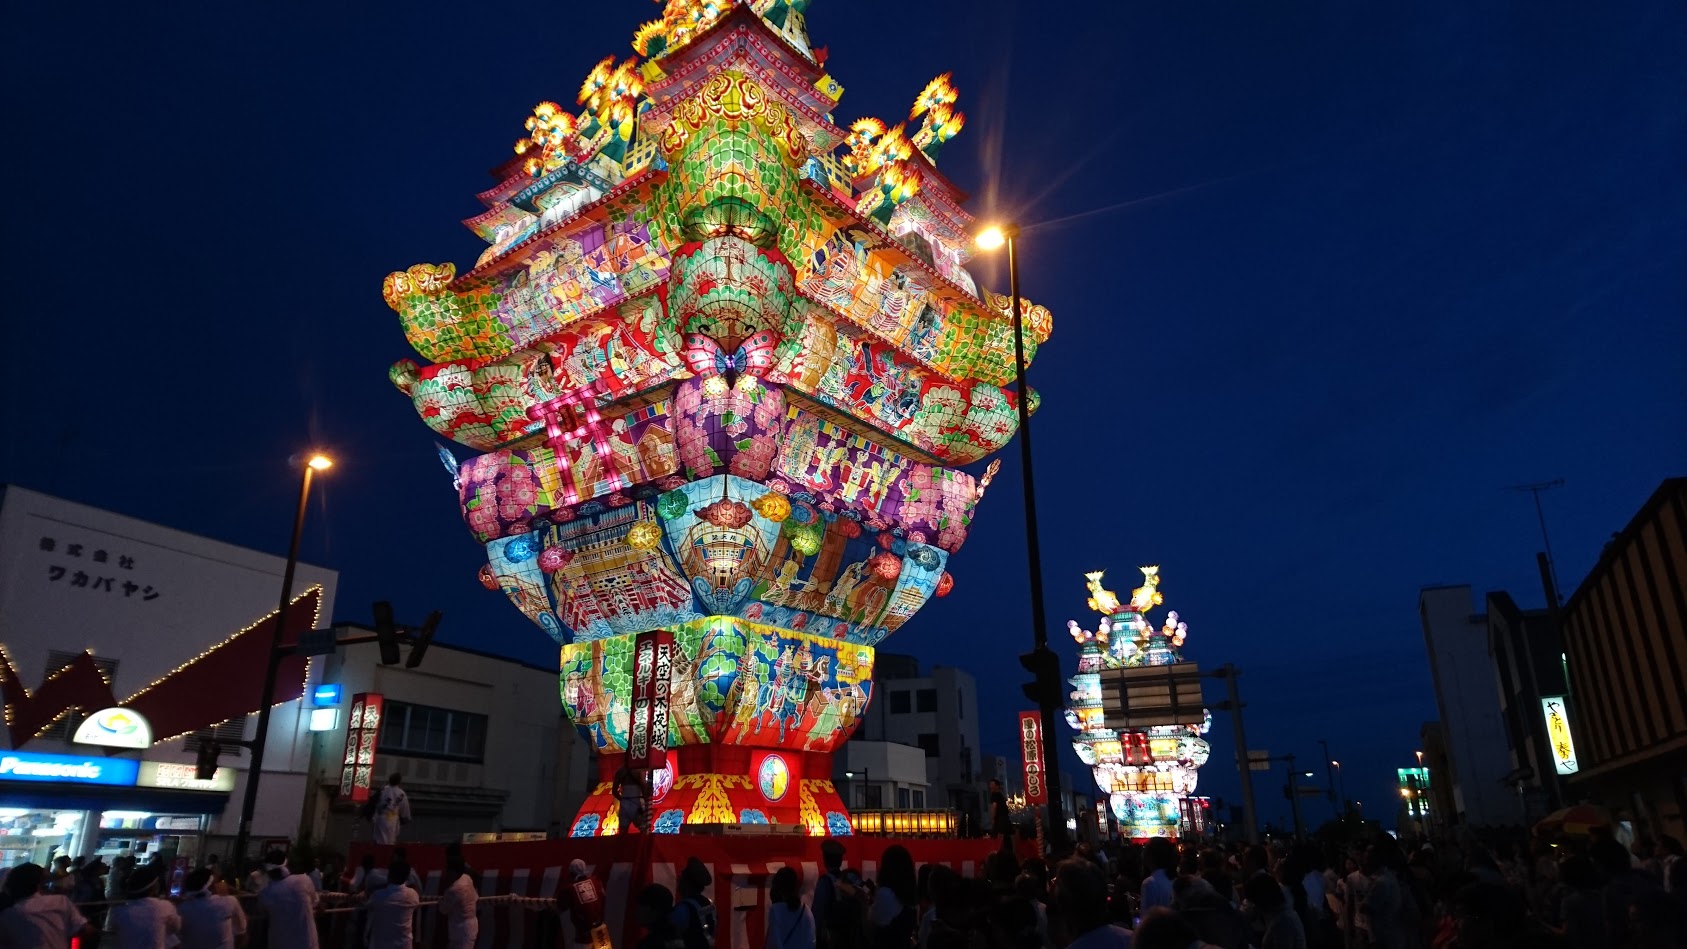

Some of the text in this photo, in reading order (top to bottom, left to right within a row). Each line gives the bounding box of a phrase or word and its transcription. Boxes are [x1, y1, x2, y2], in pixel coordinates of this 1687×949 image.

[39, 537, 135, 570] 株式会社
[48, 565, 160, 601] ワカバヤシ
[632, 641, 653, 759] エネルギーのまち能代
[651, 645, 672, 751] 天空の不夜城
[0, 756, 102, 779] Panasonic
